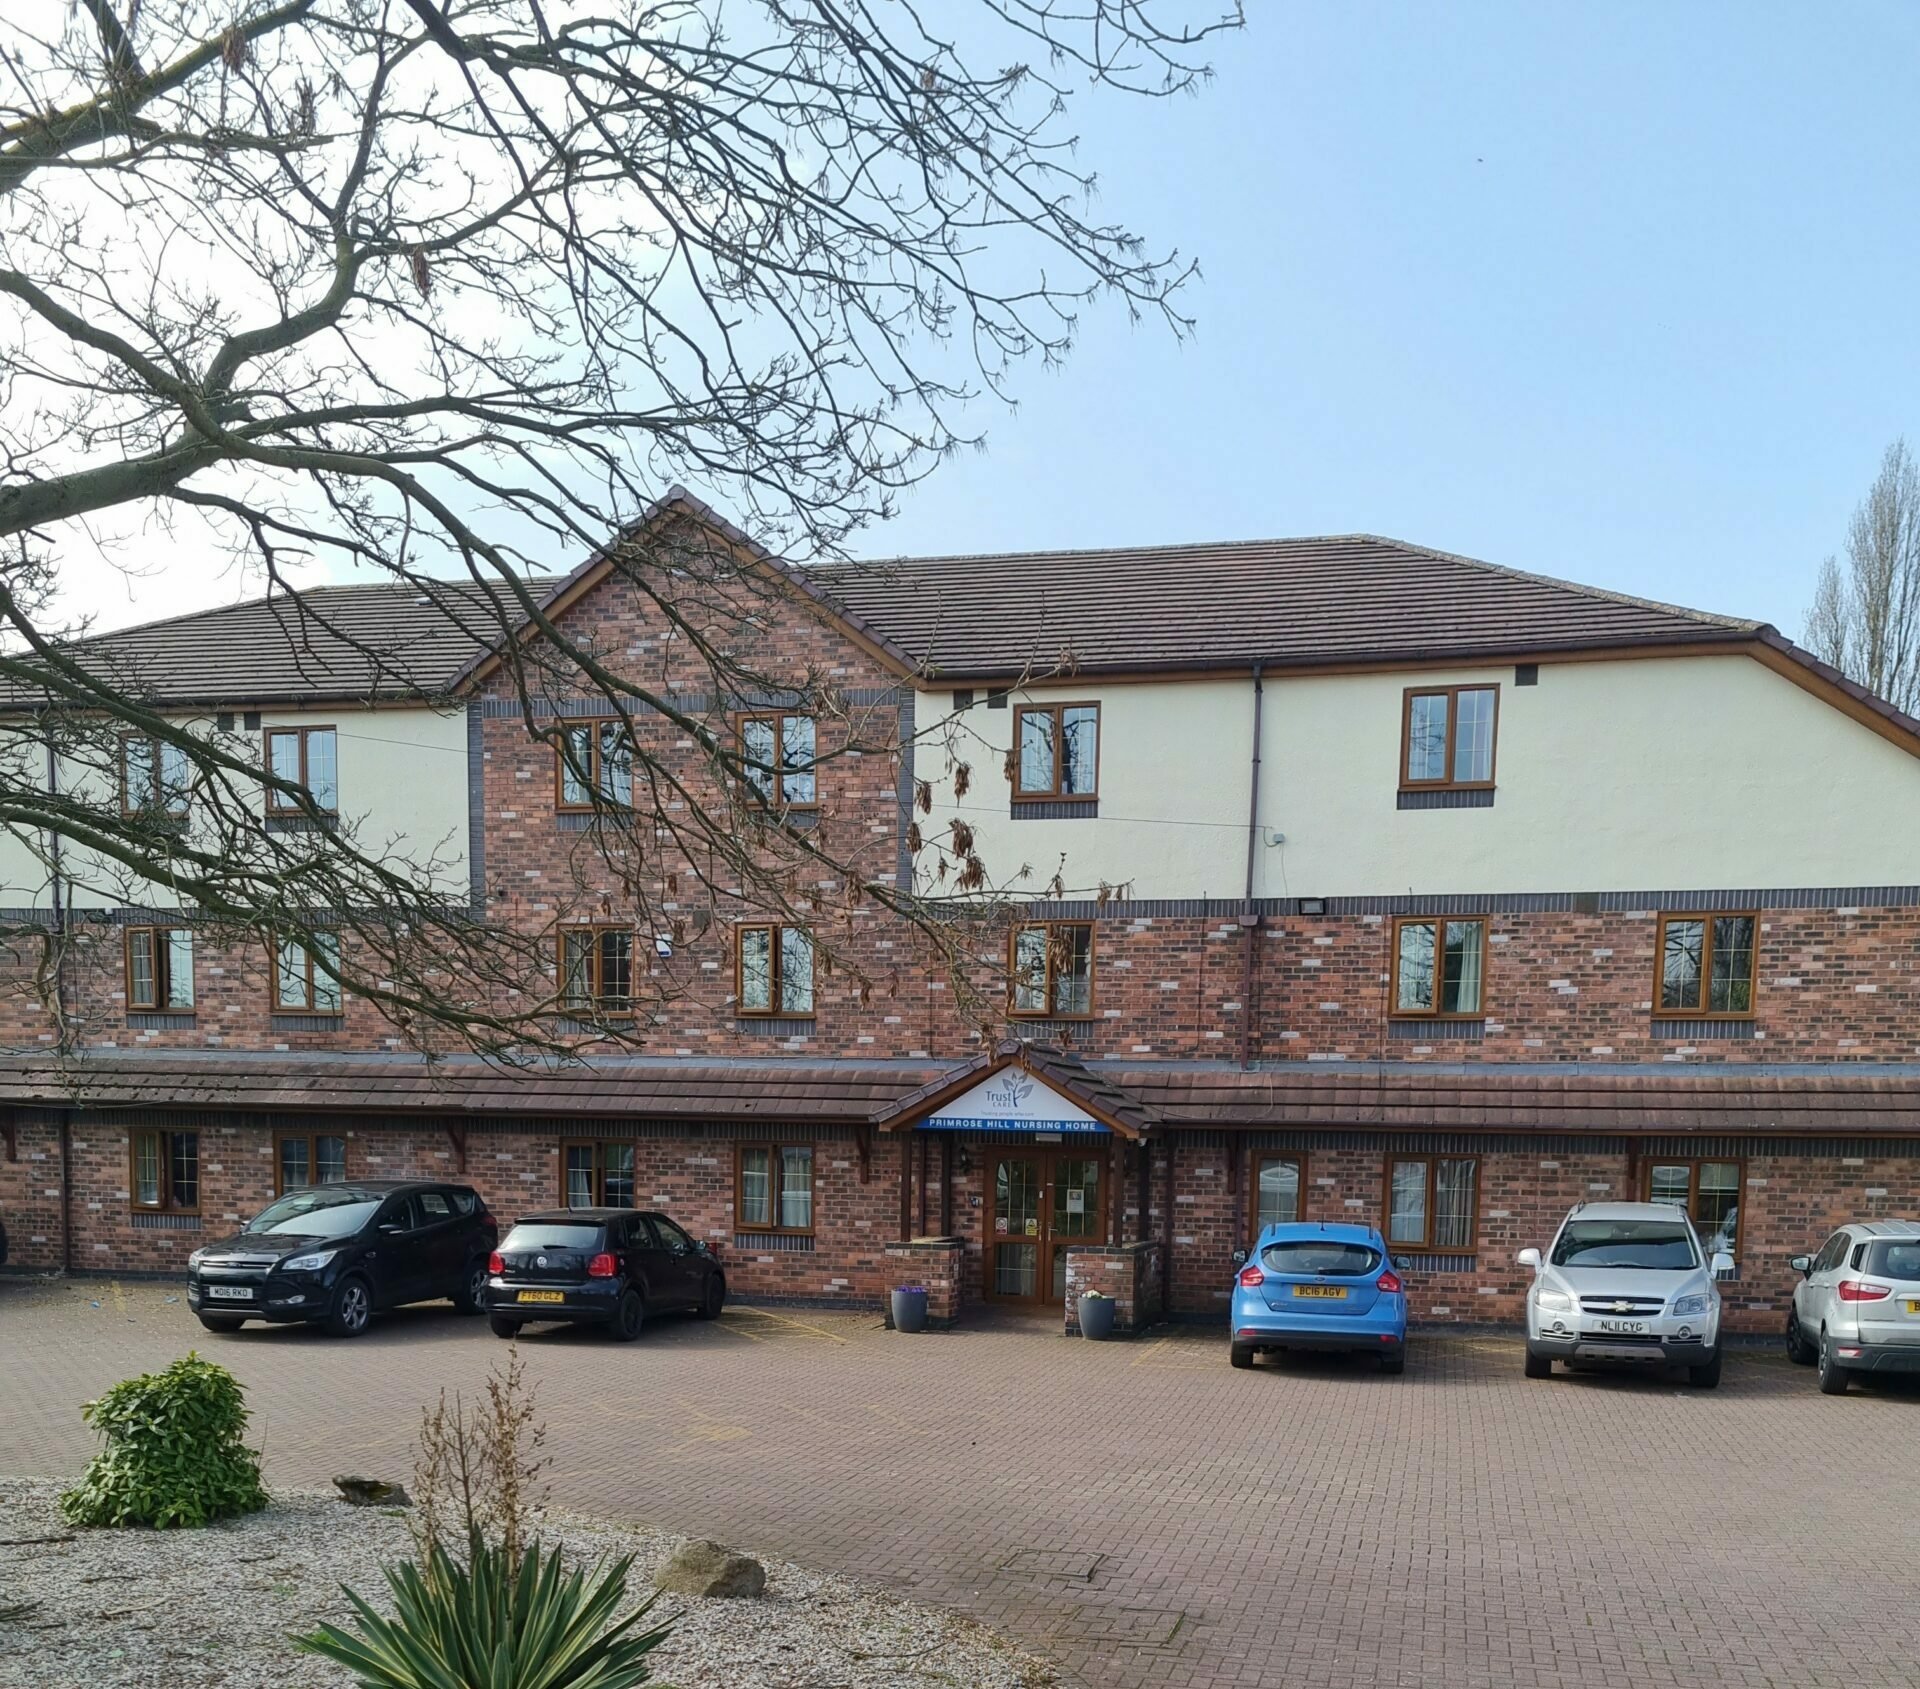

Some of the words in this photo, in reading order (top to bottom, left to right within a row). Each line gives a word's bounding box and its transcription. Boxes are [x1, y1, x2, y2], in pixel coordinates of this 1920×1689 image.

[986, 1091, 1012, 1102] Trust
[929, 1119, 983, 1128] PRIMROSE
[987, 1120, 1010, 1129] HILL
[1014, 1121, 1061, 1130] NURSING
[1065, 1122, 1097, 1131] HOME
[1299, 1286, 1320, 1296] BC16
[1322, 1287, 1341, 1297] AGV
[1601, 1320, 1620, 1331] NL11
